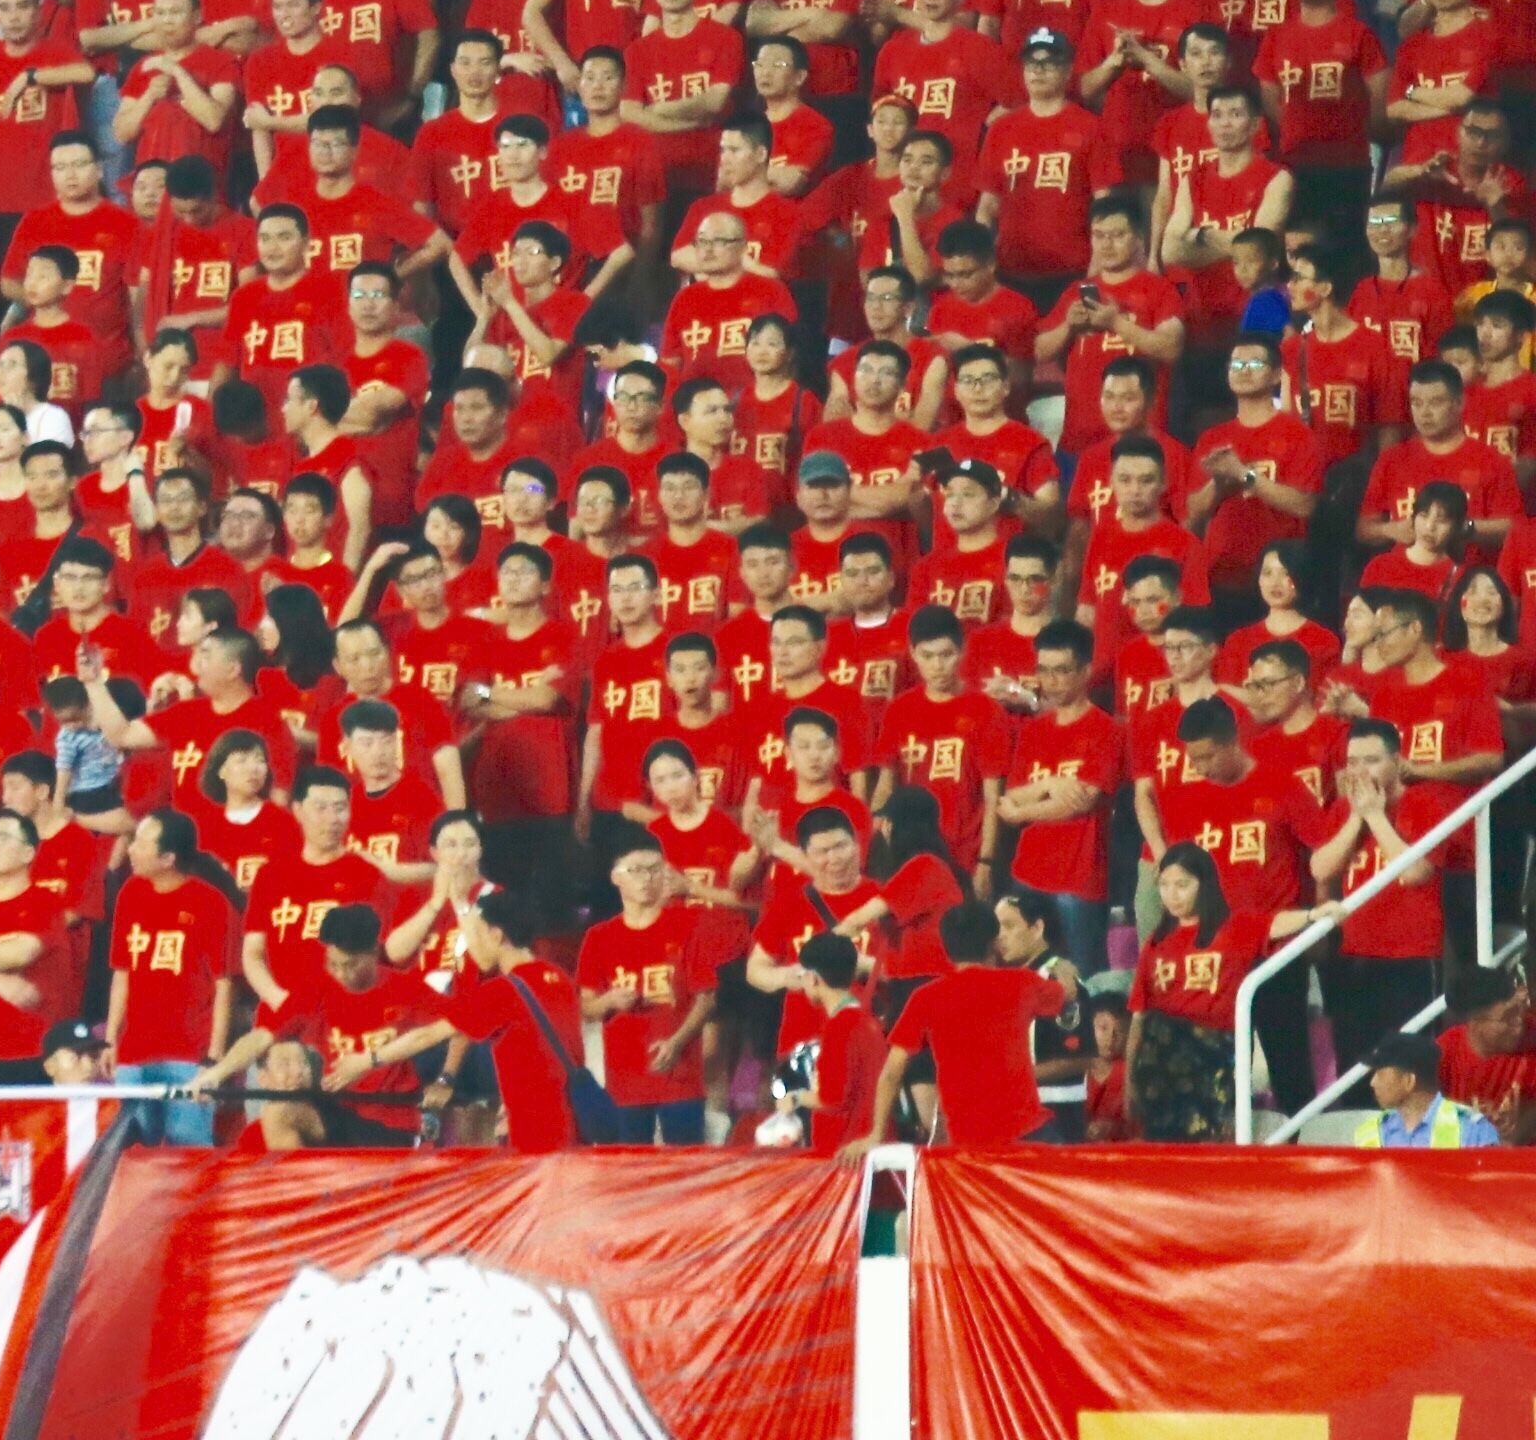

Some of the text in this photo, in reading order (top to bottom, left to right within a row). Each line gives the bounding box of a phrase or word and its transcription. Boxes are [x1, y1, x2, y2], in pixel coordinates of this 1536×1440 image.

[319, 4, 381, 42] 中国
[1277, 61, 1344, 102] 中国
[559, 165, 623, 204] 中国
[1003, 149, 1070, 193] 中国
[244, 320, 303, 364] 中国
[682, 318, 752, 359] 中国
[656, 578, 720, 620] 中国
[831, 659, 894, 699] 中国
[602, 681, 662, 721] 中国
[902, 737, 964, 782] 中国
[1195, 821, 1265, 865] 中国
[128, 922, 185, 974] 中国
[1155, 952, 1222, 995] 中国
